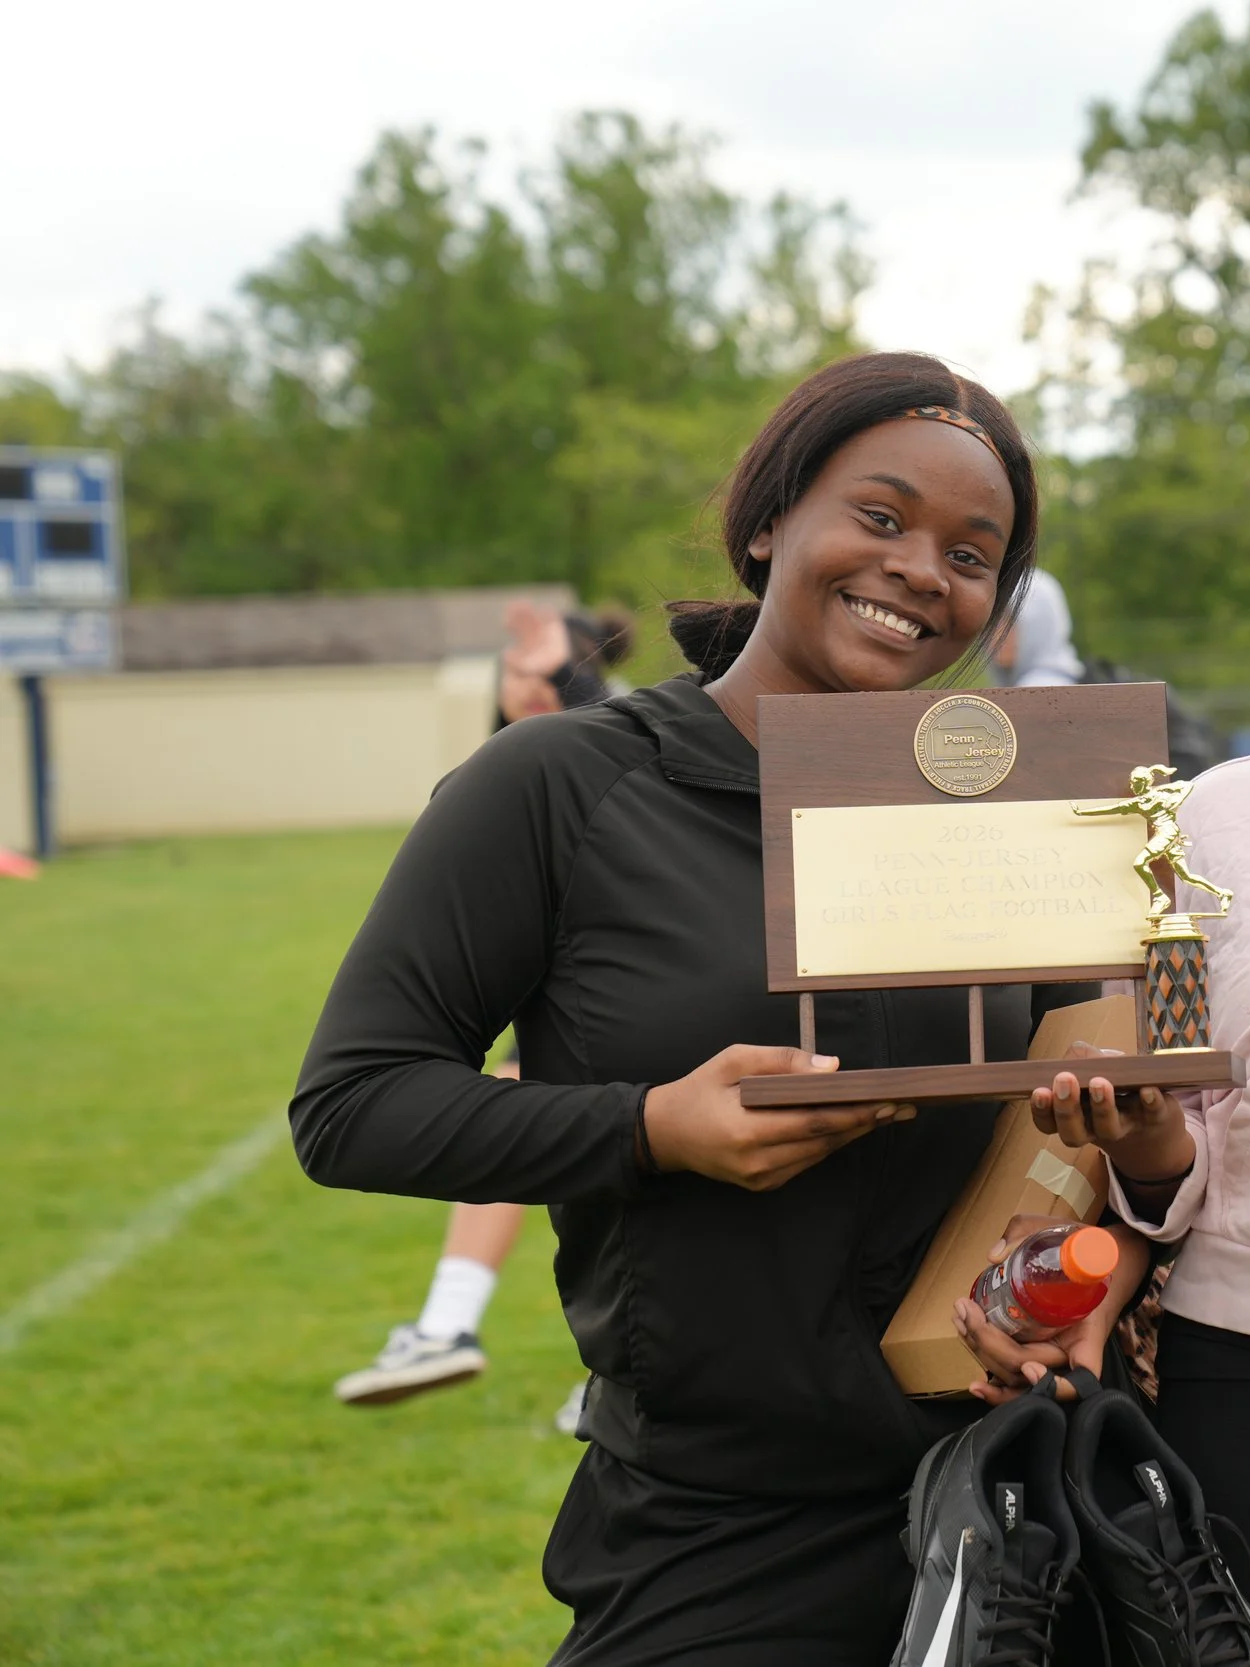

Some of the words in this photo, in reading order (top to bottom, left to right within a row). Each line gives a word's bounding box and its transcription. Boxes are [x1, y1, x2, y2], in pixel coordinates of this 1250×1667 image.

[991, 708, 1012, 743] BASKETBALL
[944, 734, 975, 744] Penn
[934, 761, 959, 769] Athletic
[959, 761, 985, 769] League
[965, 747, 1005, 758] Jersey
[937, 824, 1004, 843] 2026
[873, 847, 1068, 871] PENN-JERSEY
[839, 876, 950, 899] LEAGUE
[962, 870, 1105, 894] CHAMPION
[821, 903, 900, 925] GIRLS
[909, 900, 978, 921] FLAG
[990, 895, 1124, 918] FOOTBALL
[1145, 1466, 1167, 1508] ALPHA
[1005, 1488, 1016, 1534] ALPHA
